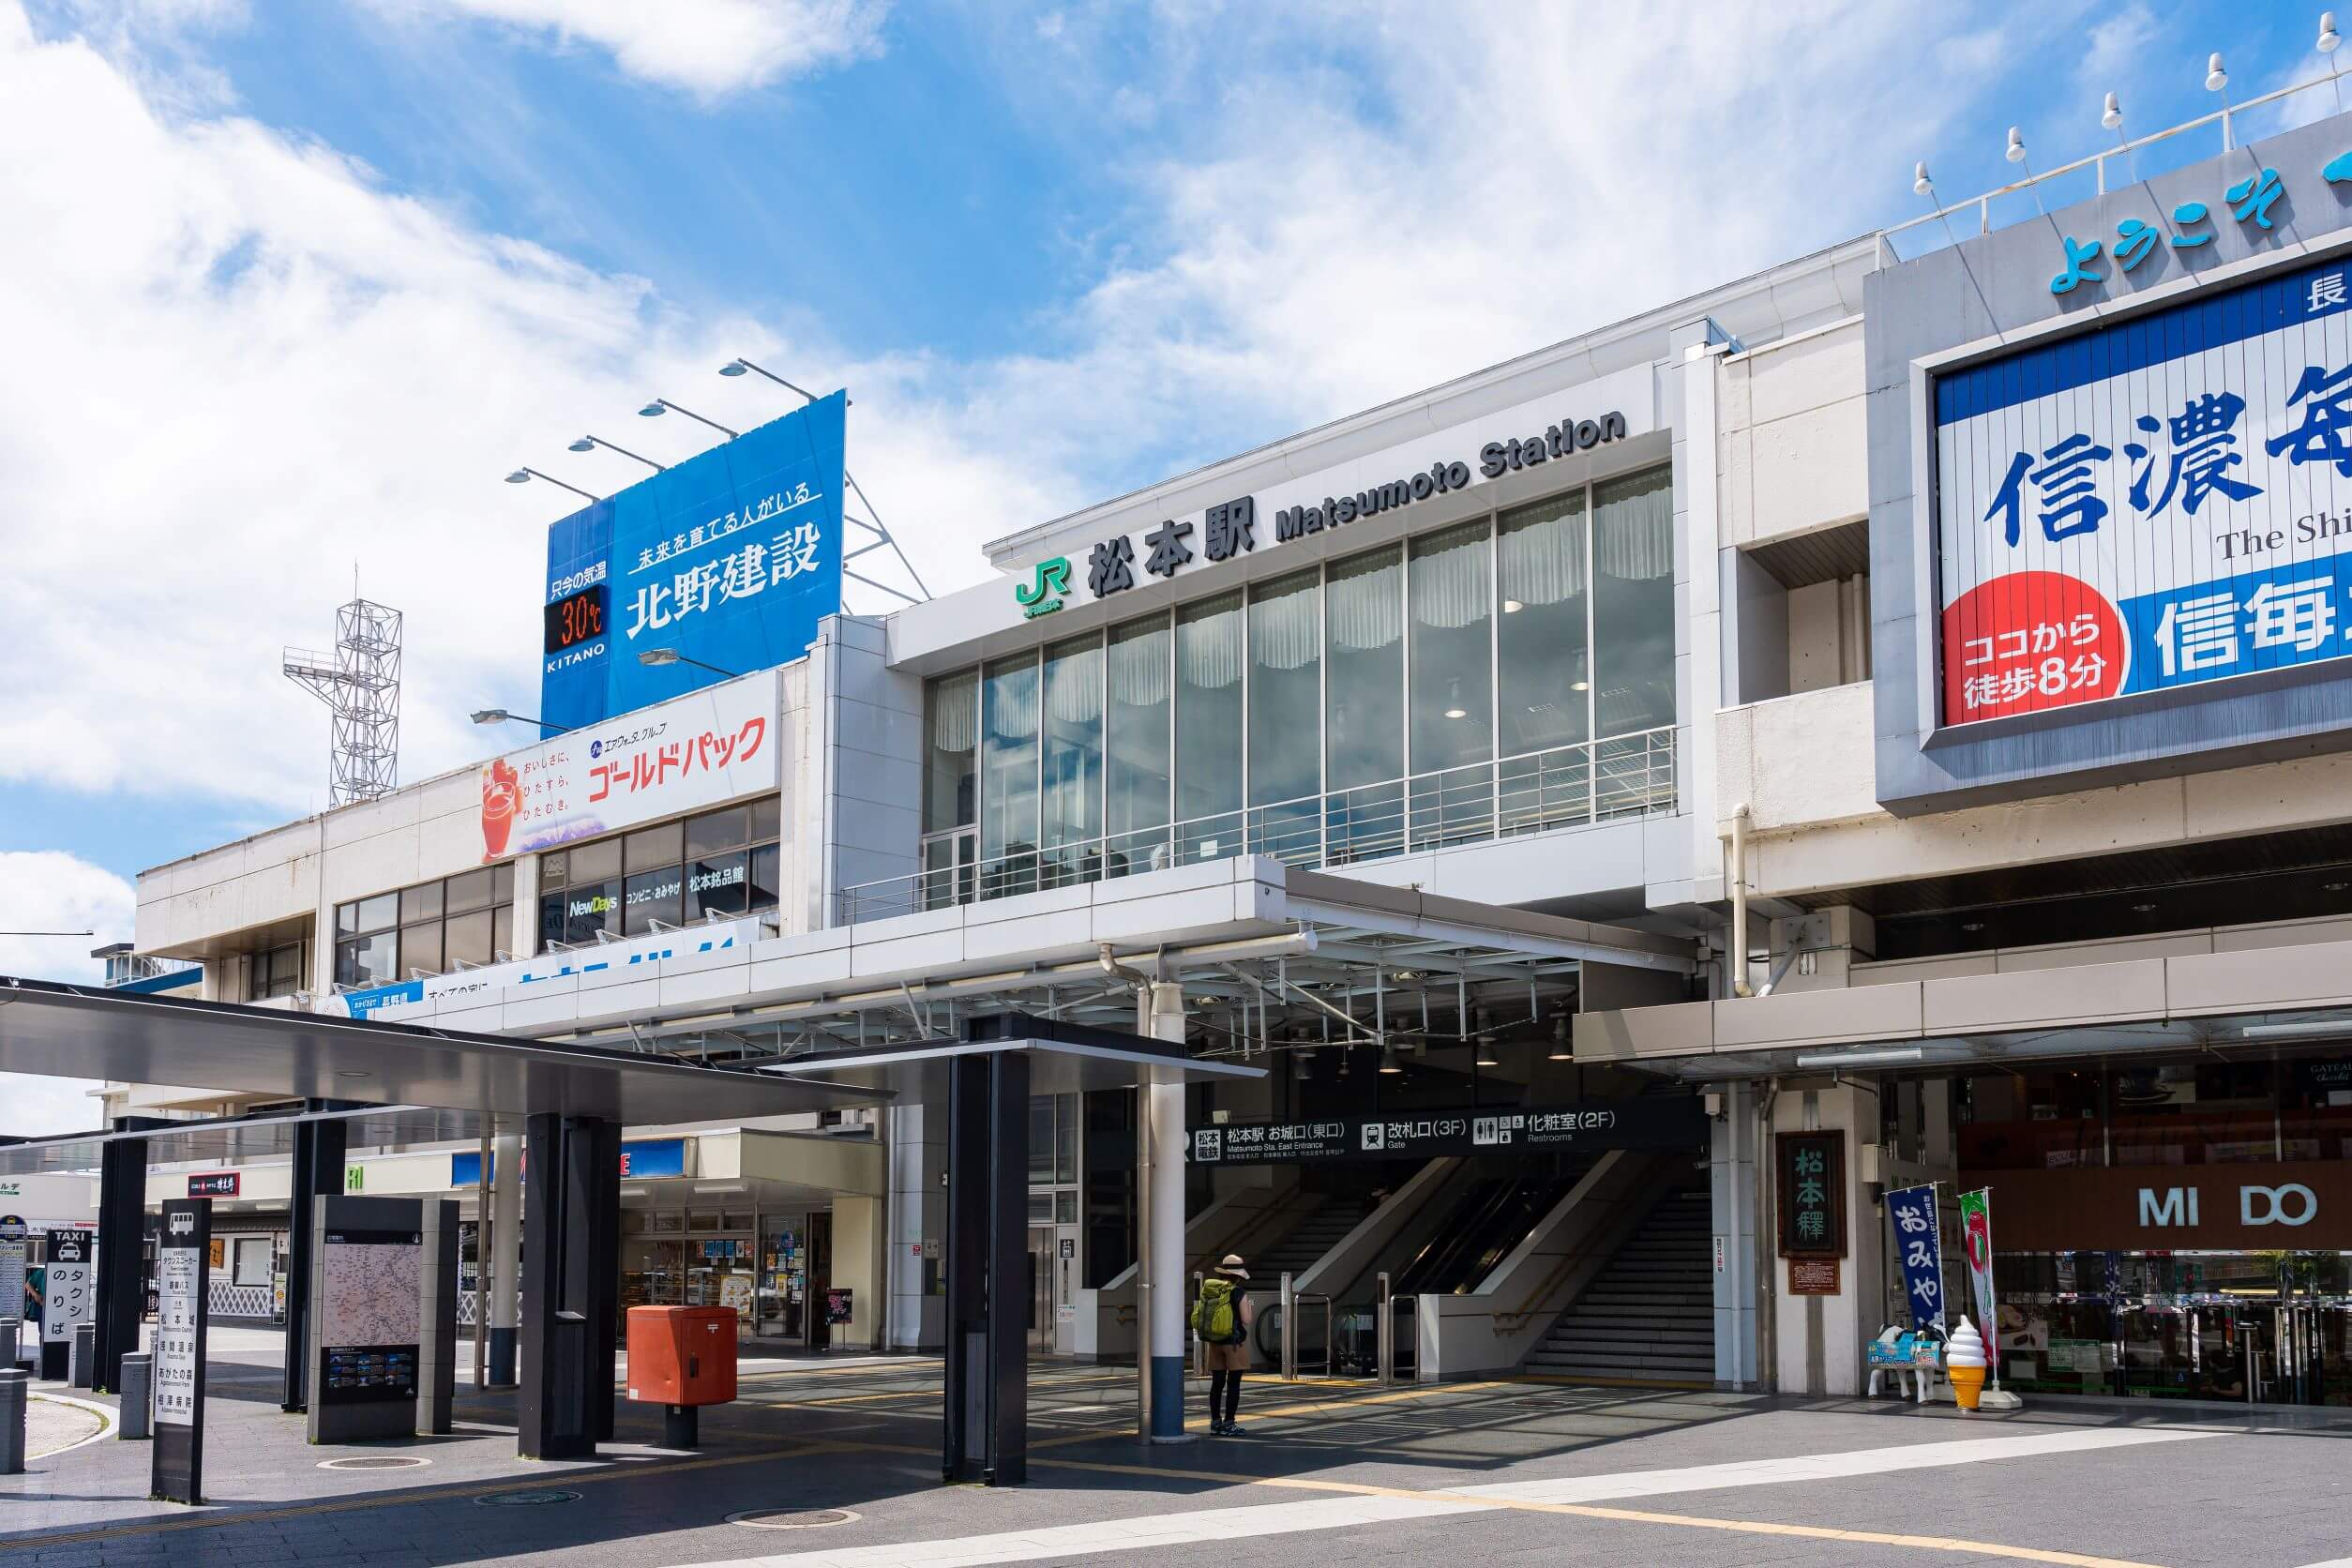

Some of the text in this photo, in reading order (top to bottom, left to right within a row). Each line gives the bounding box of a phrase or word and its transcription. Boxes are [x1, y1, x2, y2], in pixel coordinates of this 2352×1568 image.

[2050, 168, 2284, 294] ようこそ
[2307, 272, 2348, 313] 長
[1088, 410, 1626, 598] 松本駅 Matsumoto Station
[639, 482, 810, 570] 未来を育てる人がいる
[2216, 507, 2352, 560] The Shi
[551, 561, 606, 600] 只今の気温
[626, 521, 822, 641] 北野建設
[1015, 556, 1072, 605] JR
[1964, 612, 2100, 667] ココから
[2154, 576, 2352, 677] 信毎
[548, 643, 605, 673] KITANO
[1964, 654, 2107, 711] 徒歩8分
[590, 717, 765, 804] ゴールドパック
[689, 867, 745, 892] 松本銘品館
[569, 896, 617, 917] NewDays
[1227, 1122, 1345, 1143] 松本駅 お城口(東口)
[1387, 1121, 1467, 1140] 改札口(3F)
[1528, 1110, 1616, 1133] 化粧室(2F)
[1528, 1133, 1573, 1143] Restrooms
[1227, 1143, 1262, 1153] Matsumoto
[1279, 1141, 1293, 1151] East
[1294, 1140, 1324, 1150] Entrance
[1387, 1139, 1406, 1149] Gate
[2138, 1184, 2317, 1227] MI DO
[54, 1231, 85, 1241] TAXI
[52, 1269, 67, 1335] のりば
[69, 1270, 83, 1318] タクシ
